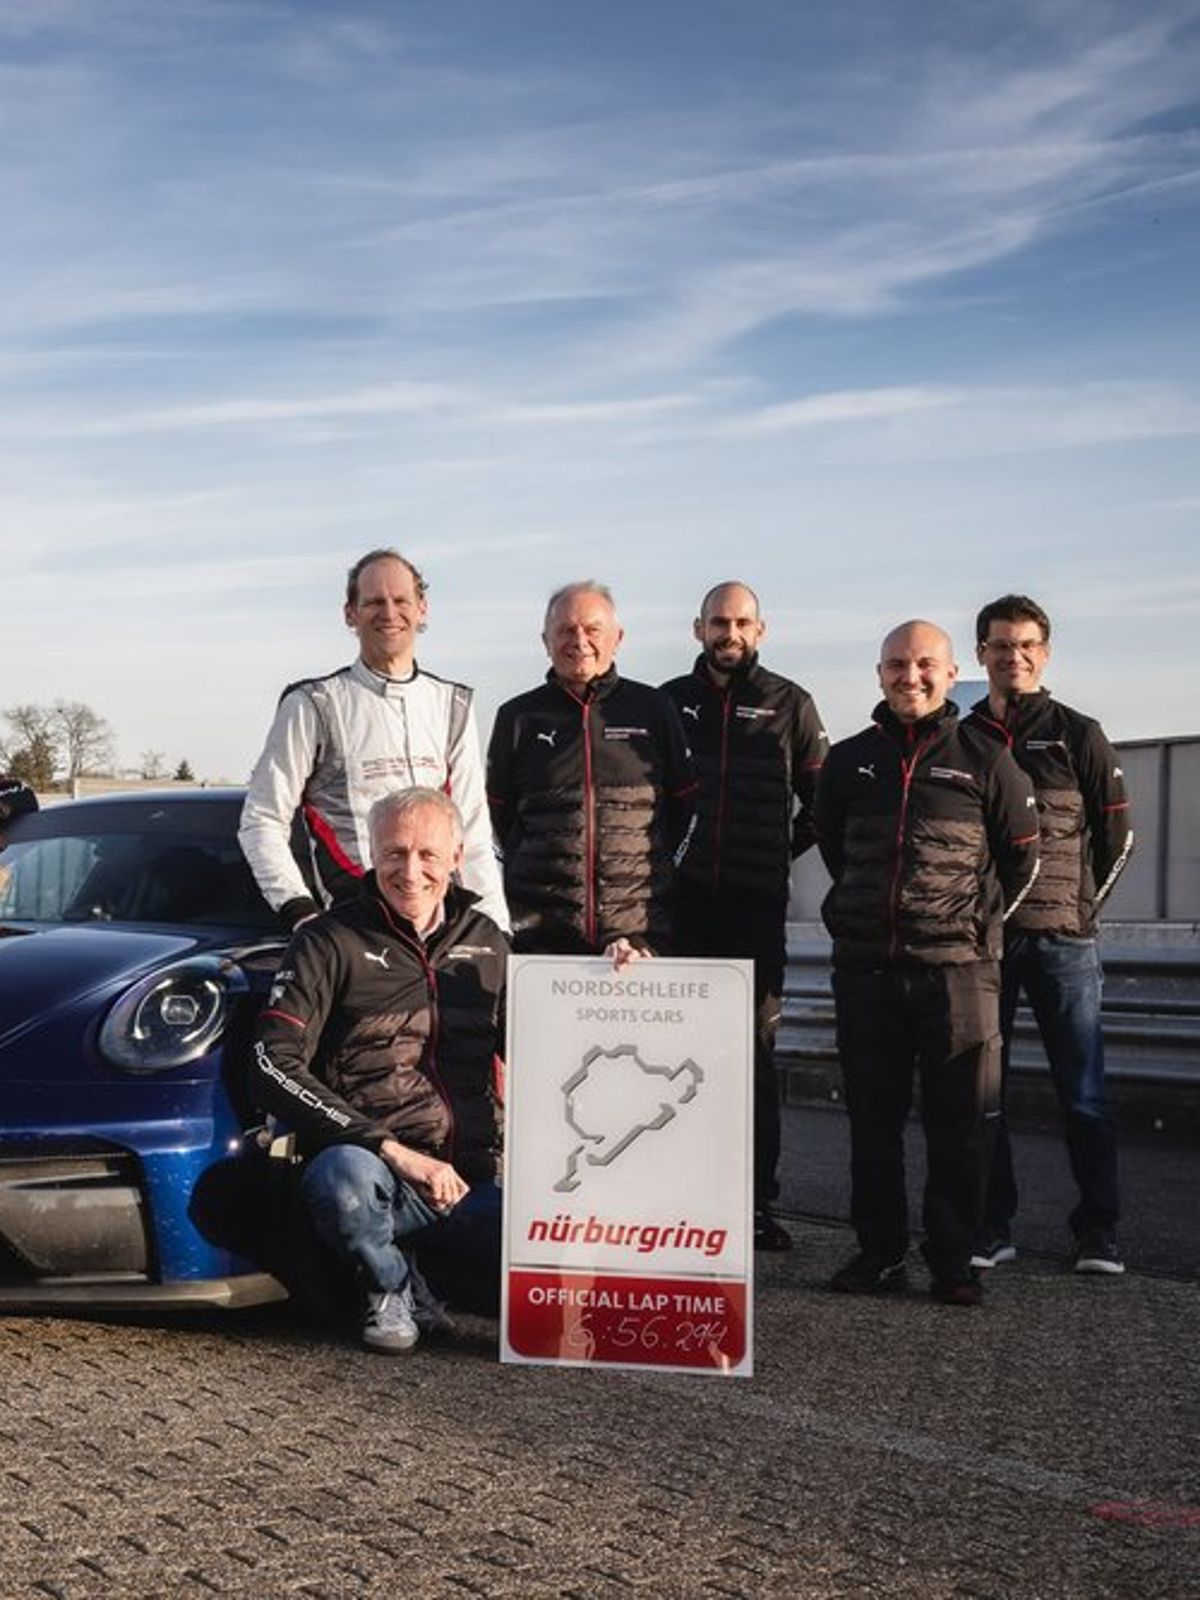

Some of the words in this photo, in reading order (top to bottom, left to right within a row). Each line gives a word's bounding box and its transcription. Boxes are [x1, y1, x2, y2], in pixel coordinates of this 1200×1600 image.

[551, 980, 709, 999] NORDSCHLEIFE
[576, 1008, 637, 1022] SPORTS
[641, 1010, 684, 1023] CARS
[254, 1041, 351, 1127] PORSCHE
[528, 1215, 727, 1256] nürburgring
[527, 1286, 624, 1309] OFFICIAL
[628, 1293, 669, 1311] LAP
[673, 1295, 725, 1314] TIME
